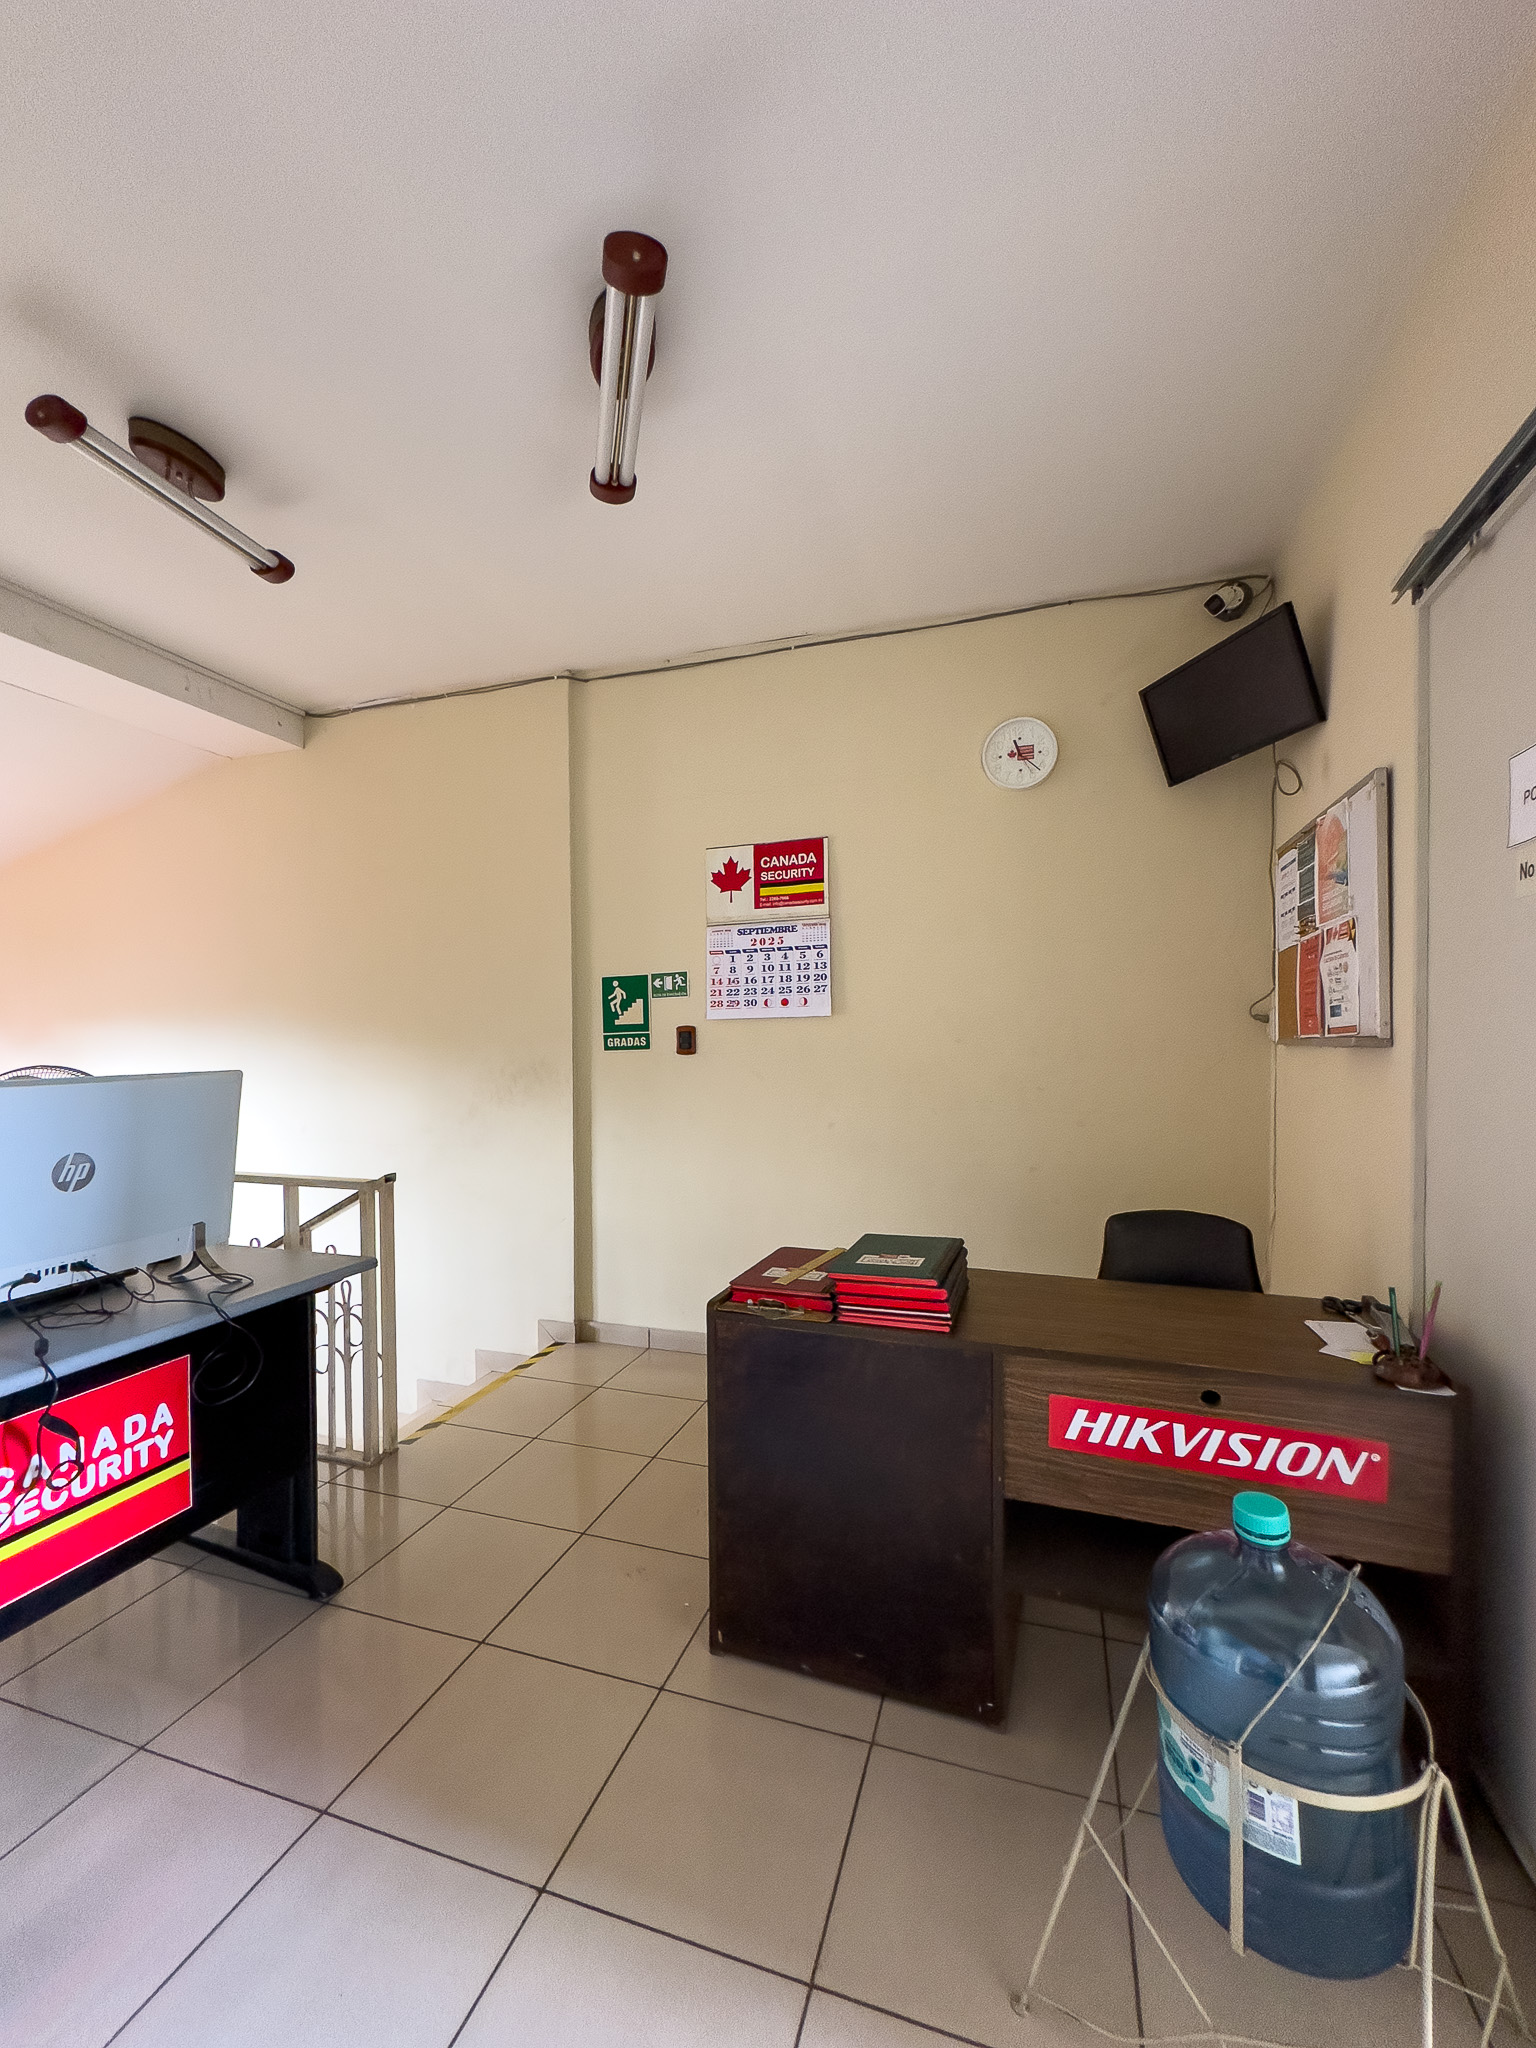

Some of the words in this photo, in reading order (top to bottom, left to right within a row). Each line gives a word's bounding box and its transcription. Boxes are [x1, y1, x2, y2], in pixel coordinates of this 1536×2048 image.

[760, 852, 817, 868] CANADA
[760, 867, 815, 881] SECURITY
[736, 925, 798, 936] SEPTIEMBRE
[750, 936, 784, 947] 2025
[607, 1036, 647, 1047] GRADAS
[56, 1153, 93, 1192] hp
